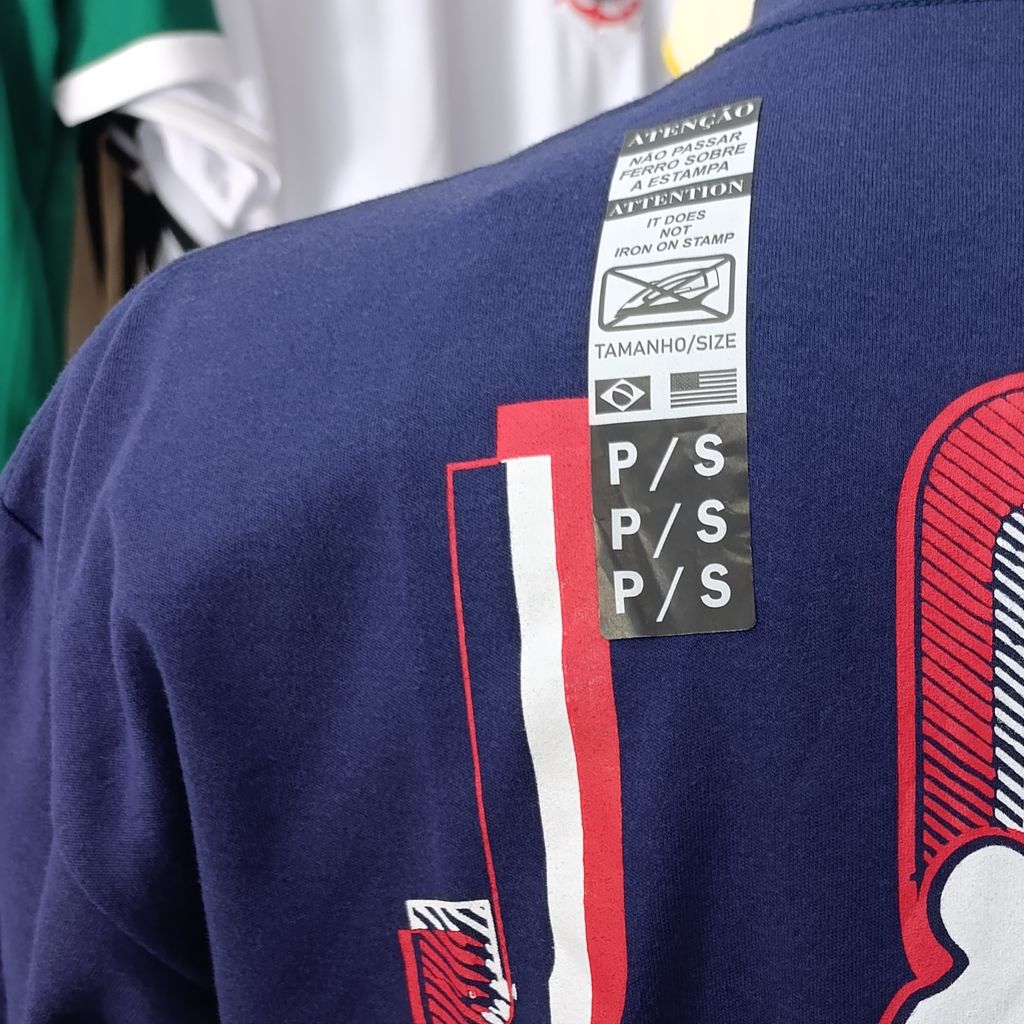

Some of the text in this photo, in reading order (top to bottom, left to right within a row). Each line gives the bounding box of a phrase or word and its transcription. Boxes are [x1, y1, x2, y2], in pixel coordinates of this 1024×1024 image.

[627, 103, 754, 147] ATENÇÃO
[619, 142, 748, 181] FERRO SOBRE
[629, 130, 743, 167] NÃO PASSAR
[630, 160, 730, 193] A ESTAMPA
[609, 179, 745, 218] ATTENTION
[646, 209, 707, 229] IT DOES
[659, 224, 692, 240] NOT
[614, 231, 736, 259] IRON ON STAMP
[594, 332, 738, 360] TAMANHO/SIZE
